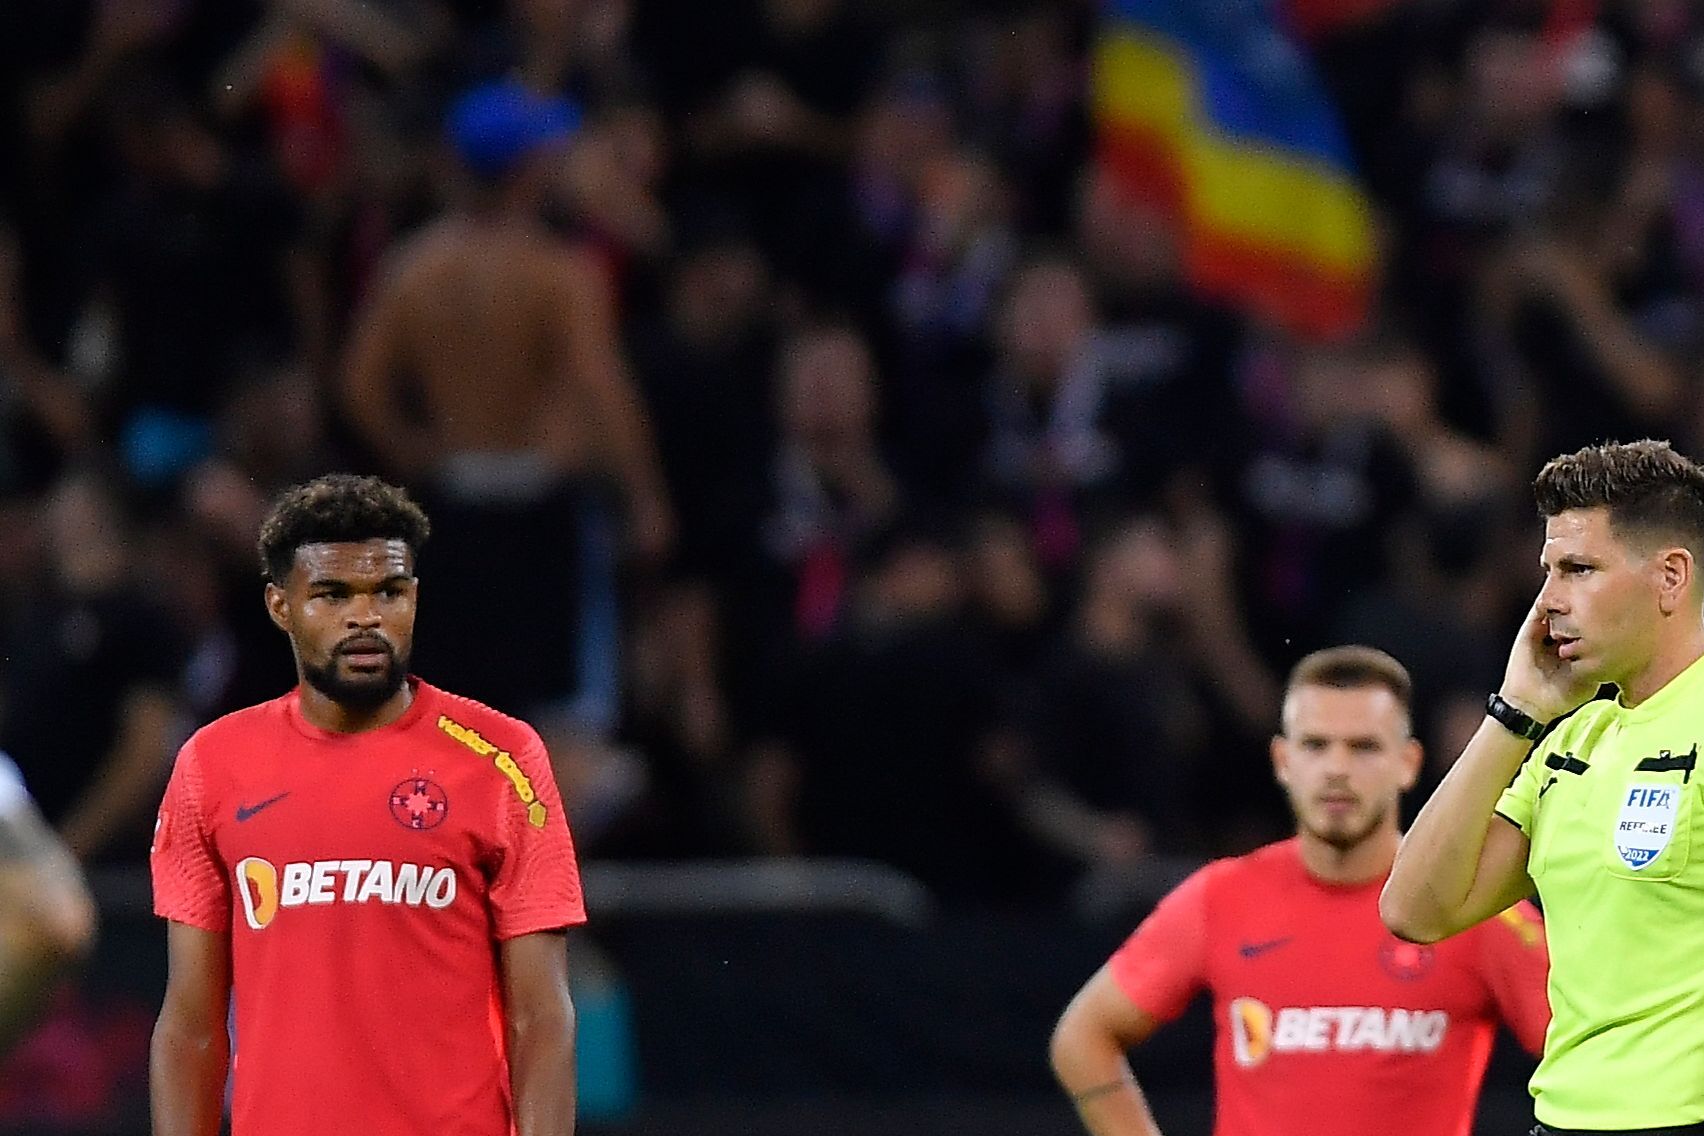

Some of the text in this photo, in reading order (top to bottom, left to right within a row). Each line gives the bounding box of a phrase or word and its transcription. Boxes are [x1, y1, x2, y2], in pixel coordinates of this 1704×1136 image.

[1627, 788, 1671, 809] FIFA
[1625, 849, 1650, 862] 2022
[280, 858, 457, 909] BETANO
[1274, 1006, 1450, 1053] BETANO
